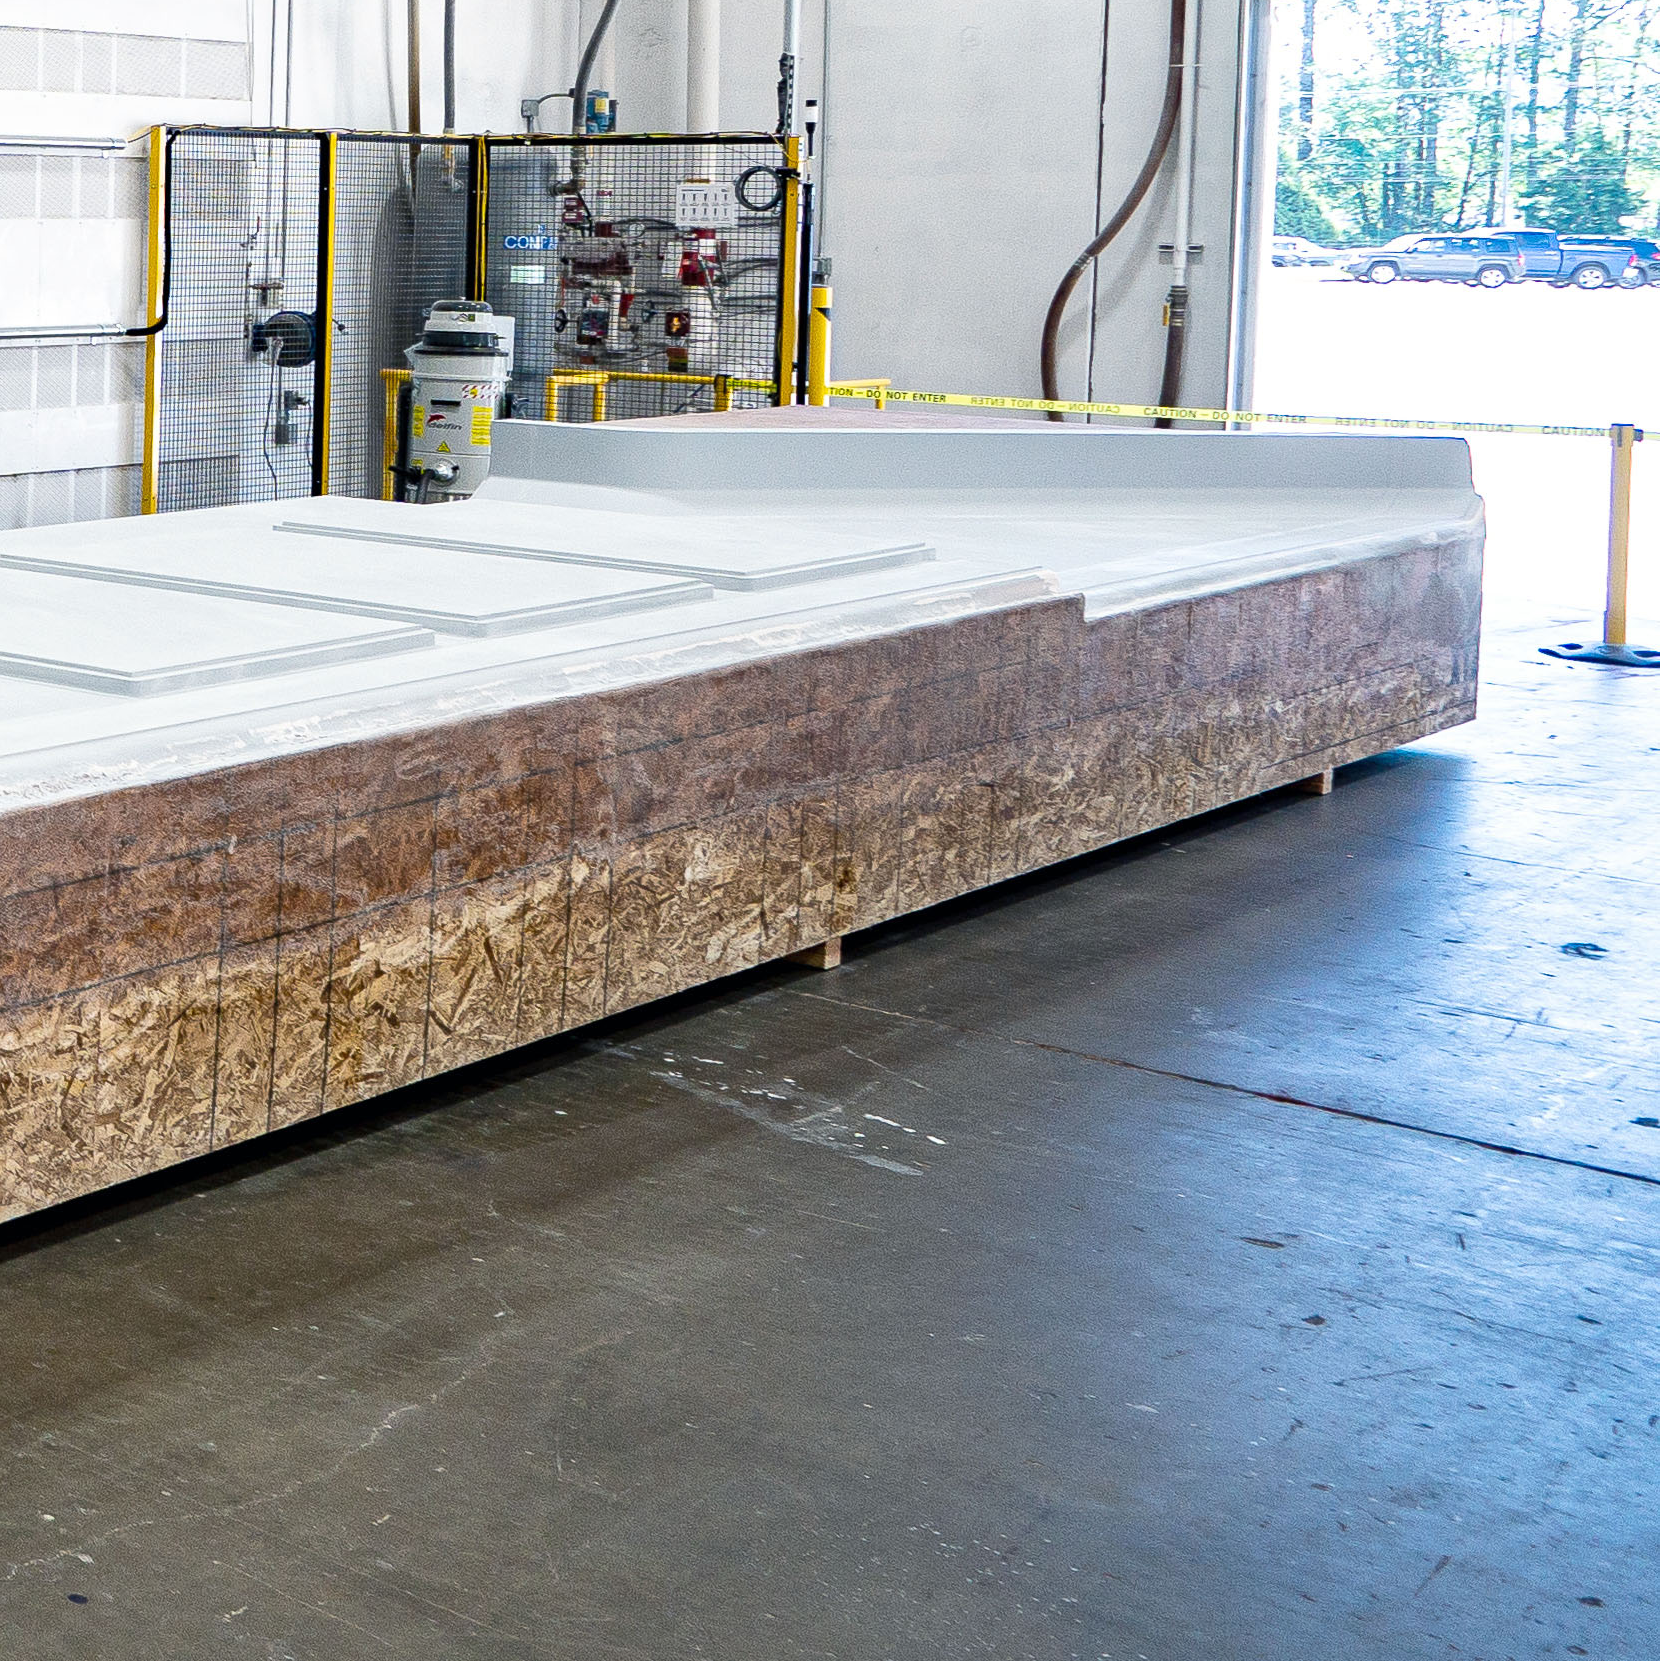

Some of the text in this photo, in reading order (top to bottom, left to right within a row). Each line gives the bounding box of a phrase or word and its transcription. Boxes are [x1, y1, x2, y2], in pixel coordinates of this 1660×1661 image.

[866, 389, 881, 399] DO
[886, 391, 908, 400] NOT
[913, 392, 947, 403] ENTER
[1143, 407, 1307, 423] CAUTION DO NOT ENTER
[428, 421, 462, 430] delfin
[1542, 426, 1605, 436] CAUTION
